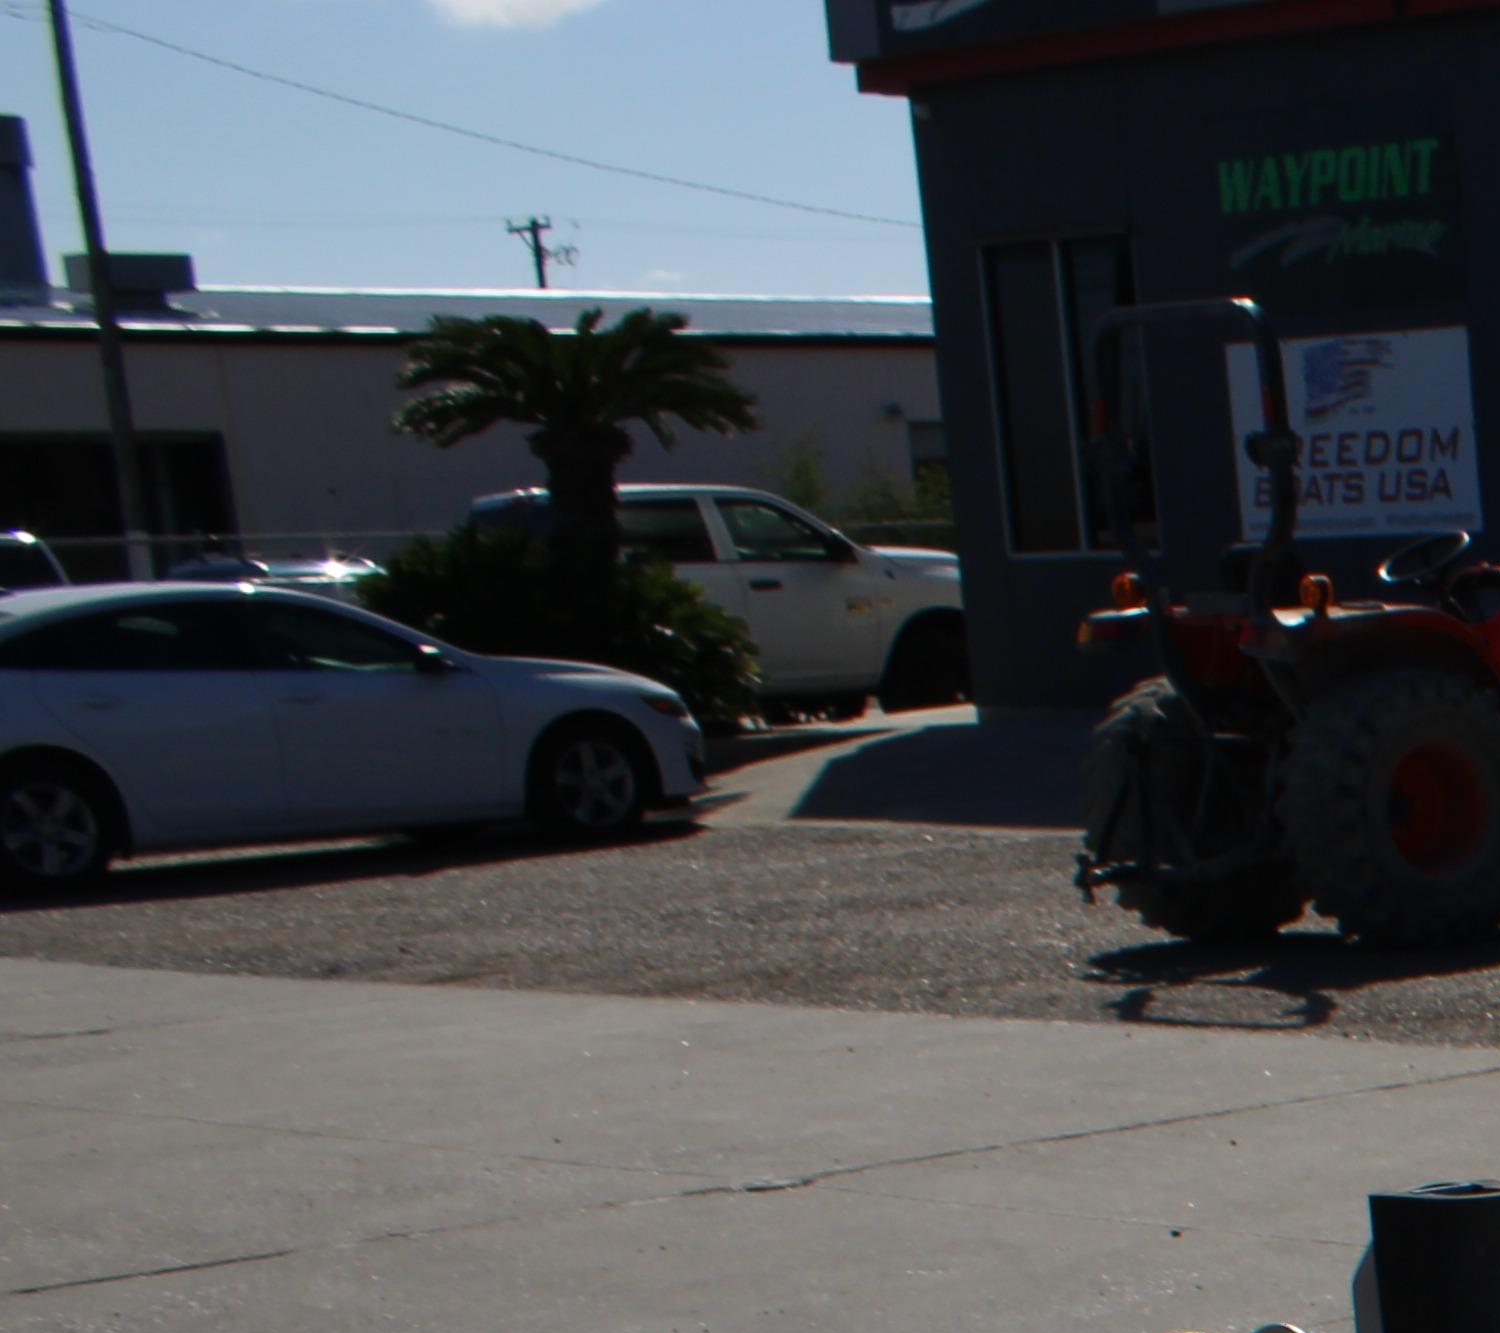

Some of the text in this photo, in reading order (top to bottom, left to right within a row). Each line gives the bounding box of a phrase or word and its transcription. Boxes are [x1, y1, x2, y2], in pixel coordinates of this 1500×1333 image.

[1217, 137, 1439, 214] WAYPOINT
[1258, 426, 1460, 470] EEDOM
[1254, 468, 1453, 508] BATS USA
